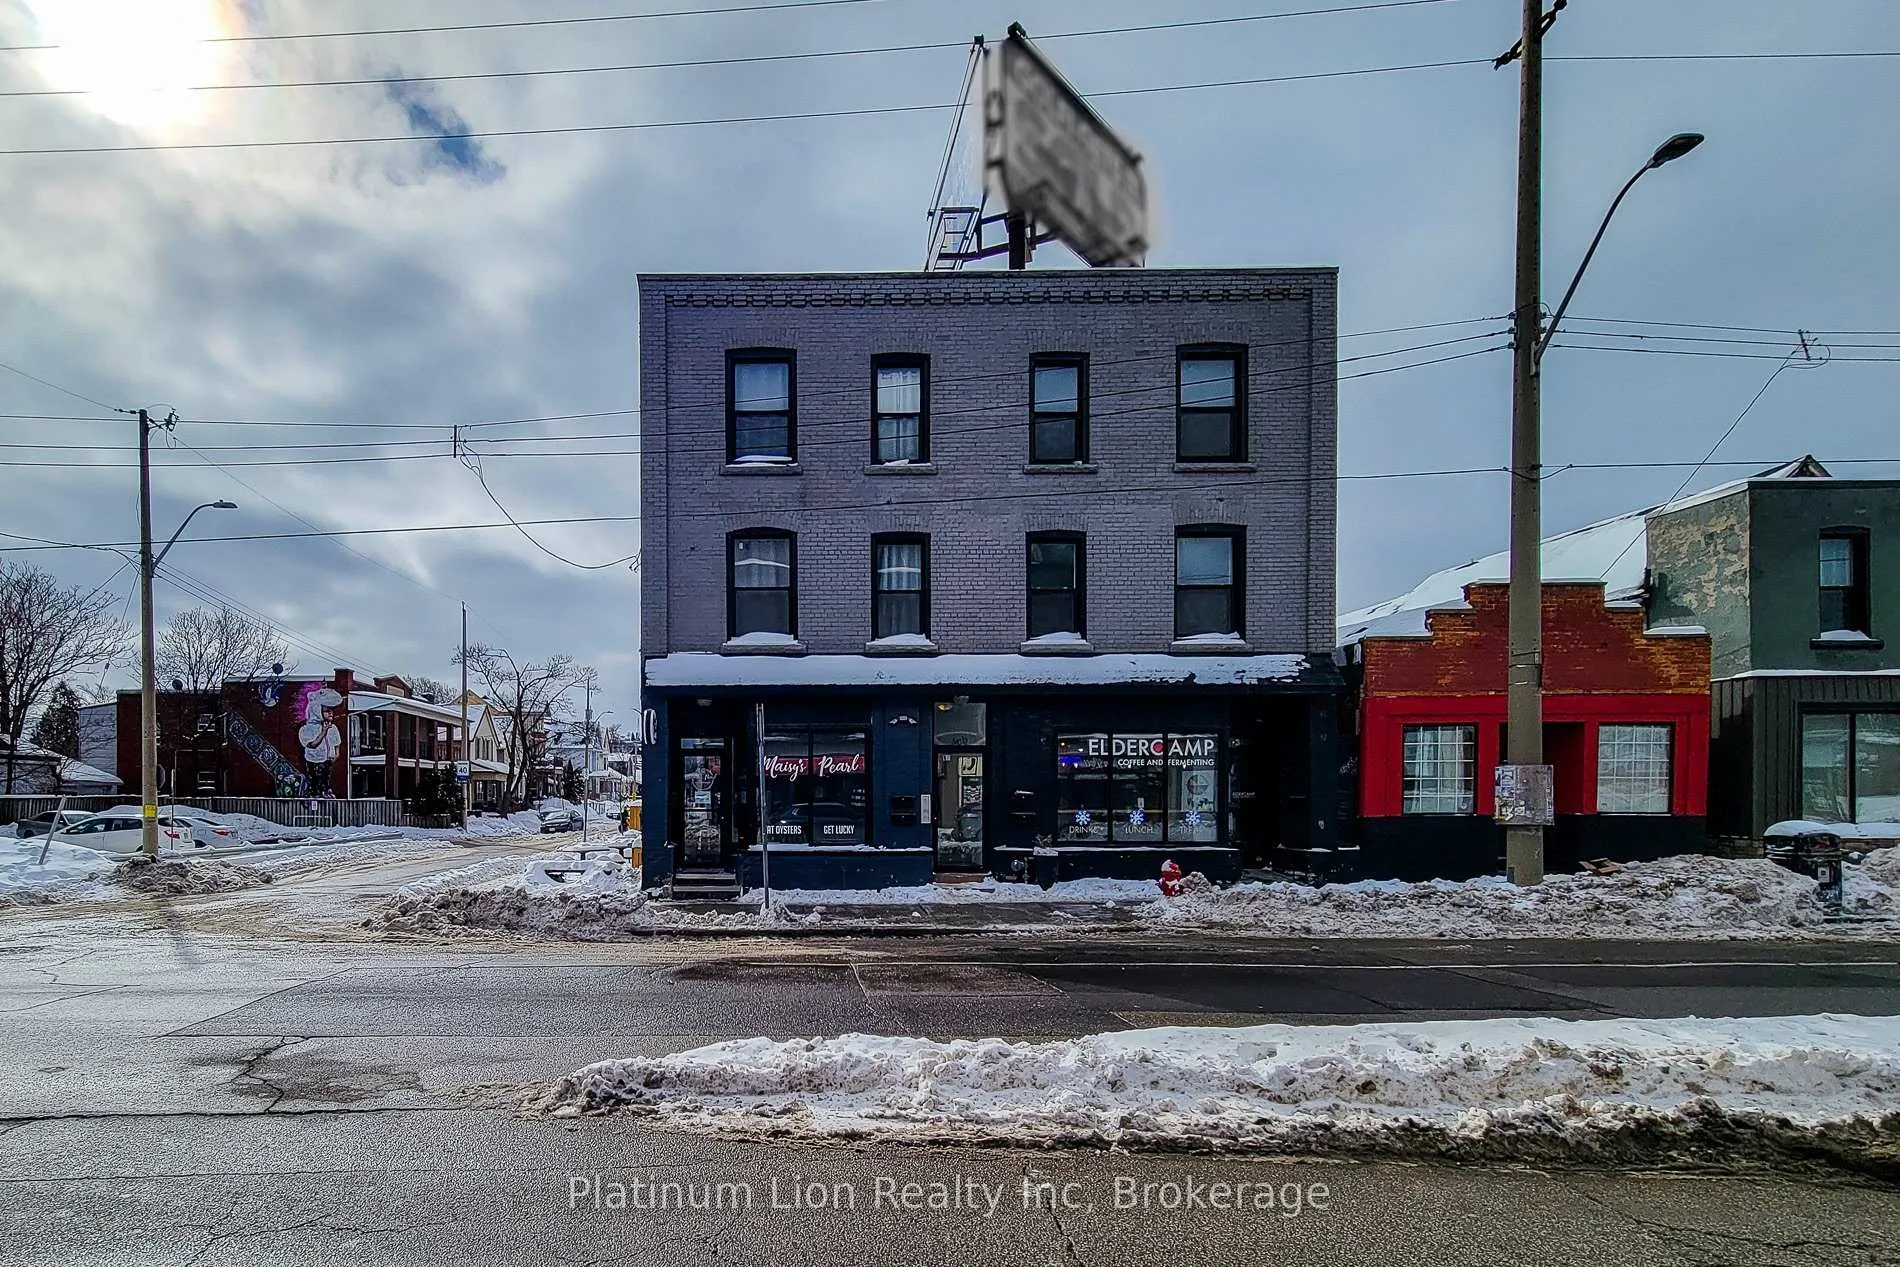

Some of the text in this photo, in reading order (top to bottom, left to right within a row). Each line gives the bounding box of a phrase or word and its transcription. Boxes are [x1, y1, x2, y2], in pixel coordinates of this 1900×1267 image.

[1088, 739, 1214, 756] ELDERCAMP
[818, 754, 859, 776] Pearl
[766, 825, 802, 834] AT OYSTERS
[823, 825, 854, 834] GET LUCKY
[1125, 826, 1153, 834] LUNCH
